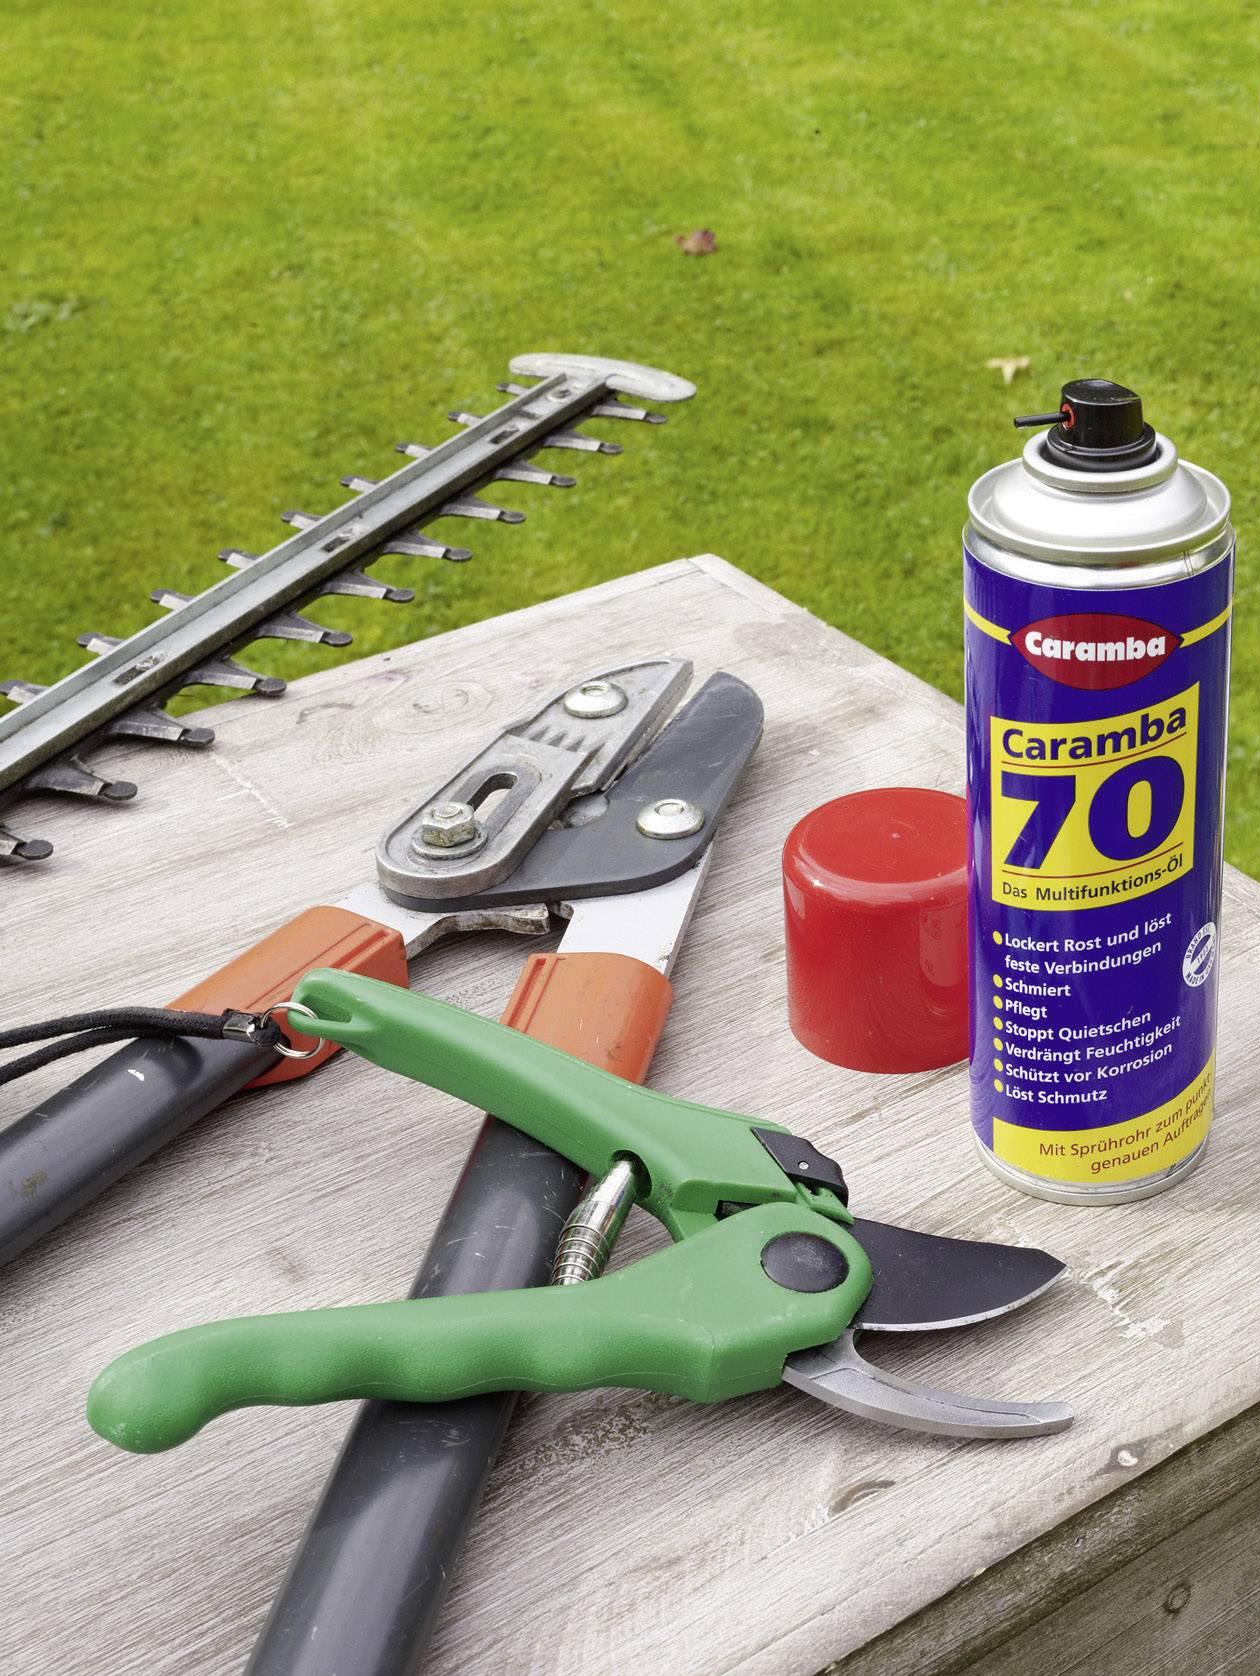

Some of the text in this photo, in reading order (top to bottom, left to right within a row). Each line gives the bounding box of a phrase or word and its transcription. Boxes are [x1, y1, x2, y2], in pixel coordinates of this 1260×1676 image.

[1025, 631, 1166, 662] Caramba
[1002, 706, 1187, 761] Caramba
[1001, 755, 1185, 869] 70
[1003, 854, 1183, 901] Das Multifunktions-Öl
[1005, 913, 1172, 952] Lockert Rost und löst
[1005, 942, 1162, 975] feste Verbindungen
[1005, 978, 1071, 997] Schmiert
[1005, 999, 1047, 1020] Pflegt
[1005, 1012, 1151, 1042] Stoppt Quietschen
[1005, 1015, 1182, 1065] Verdrängt Feuchtigkeit
[1006, 1044, 1173, 1083] Schützt vor Korrosion
[1006, 1084, 1108, 1104] Löst Schmutz
[1039, 1143, 1066, 1156] Mit
[1071, 1127, 1151, 1158] Sprührohr
[1155, 1108, 1183, 1133] zum
[1091, 1141, 1159, 1174] genauen
